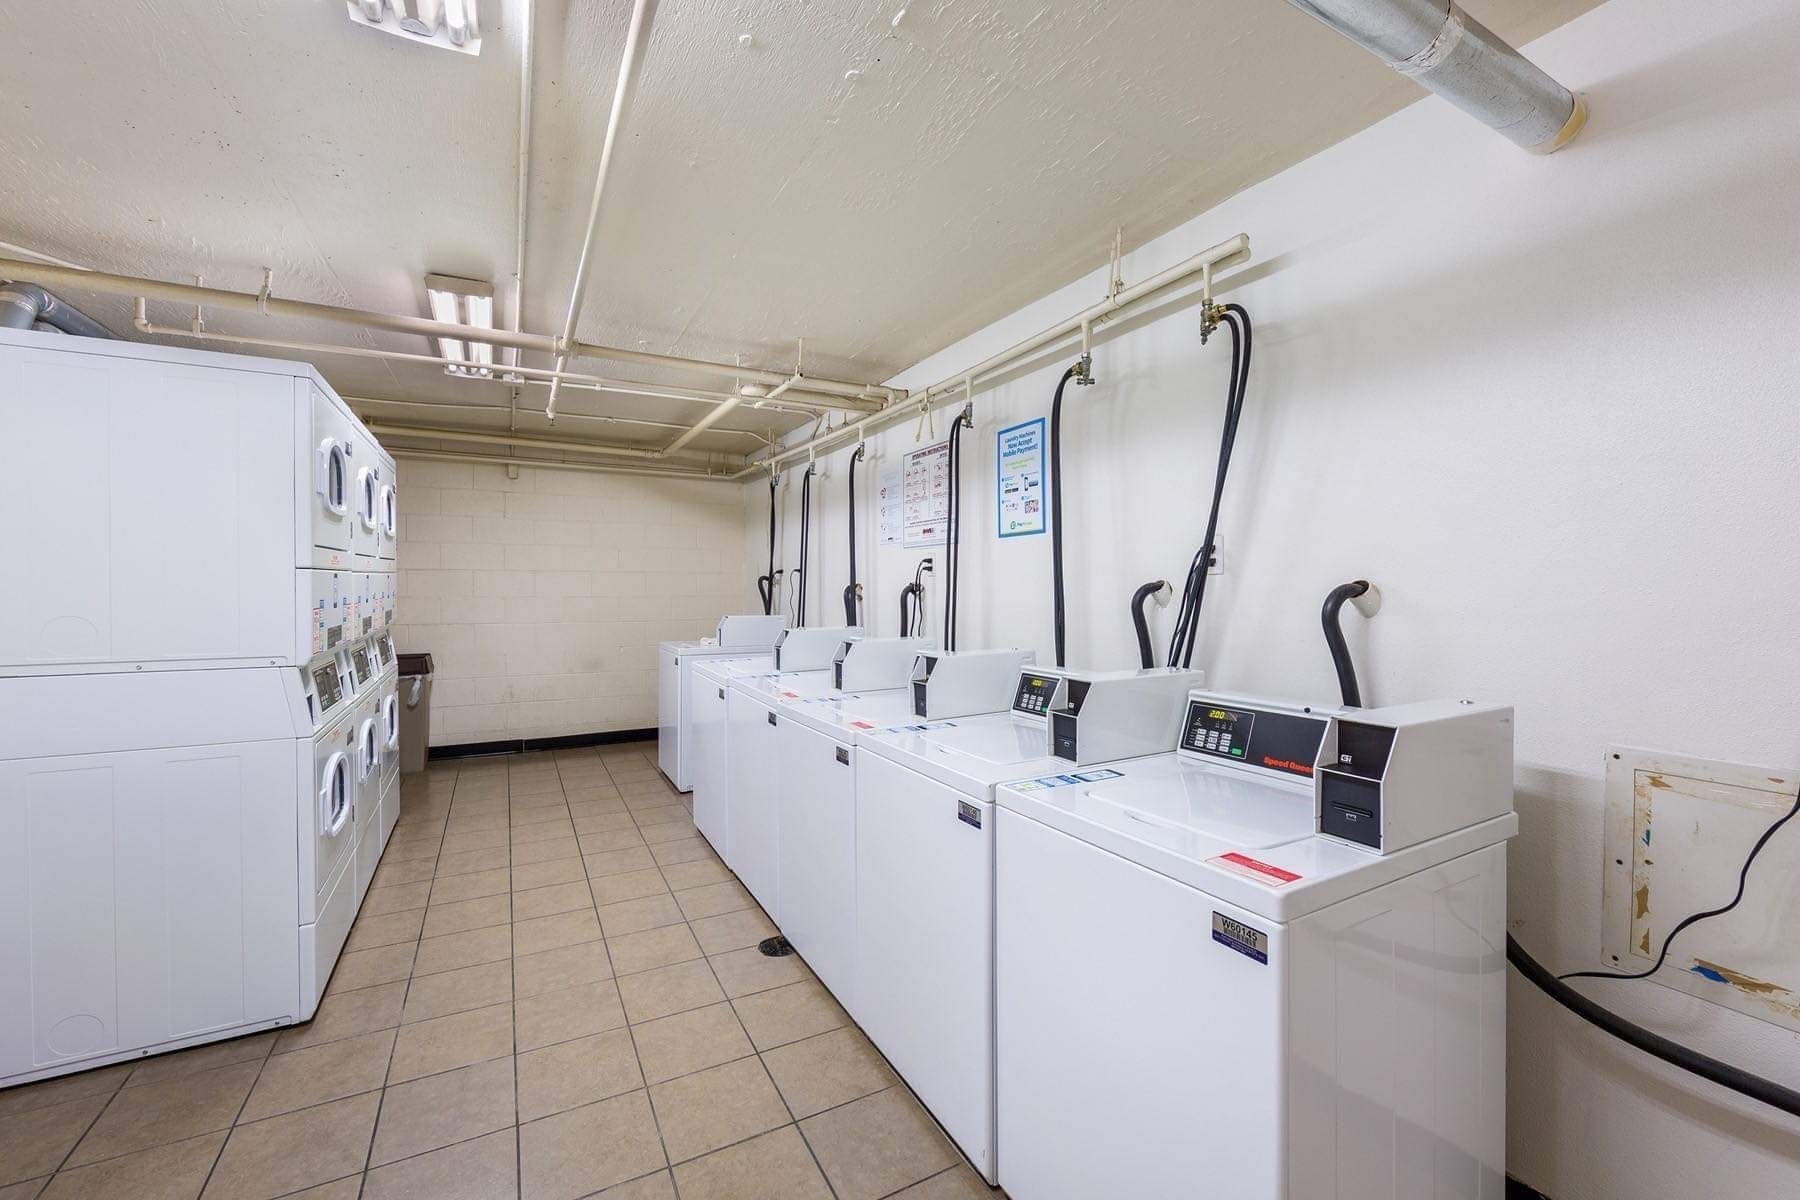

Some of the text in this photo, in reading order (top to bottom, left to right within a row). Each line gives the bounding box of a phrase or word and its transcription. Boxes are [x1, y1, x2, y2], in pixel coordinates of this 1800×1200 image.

[1263, 756, 1313, 773] Speed Queen
[1221, 917, 1258, 942] W60145
